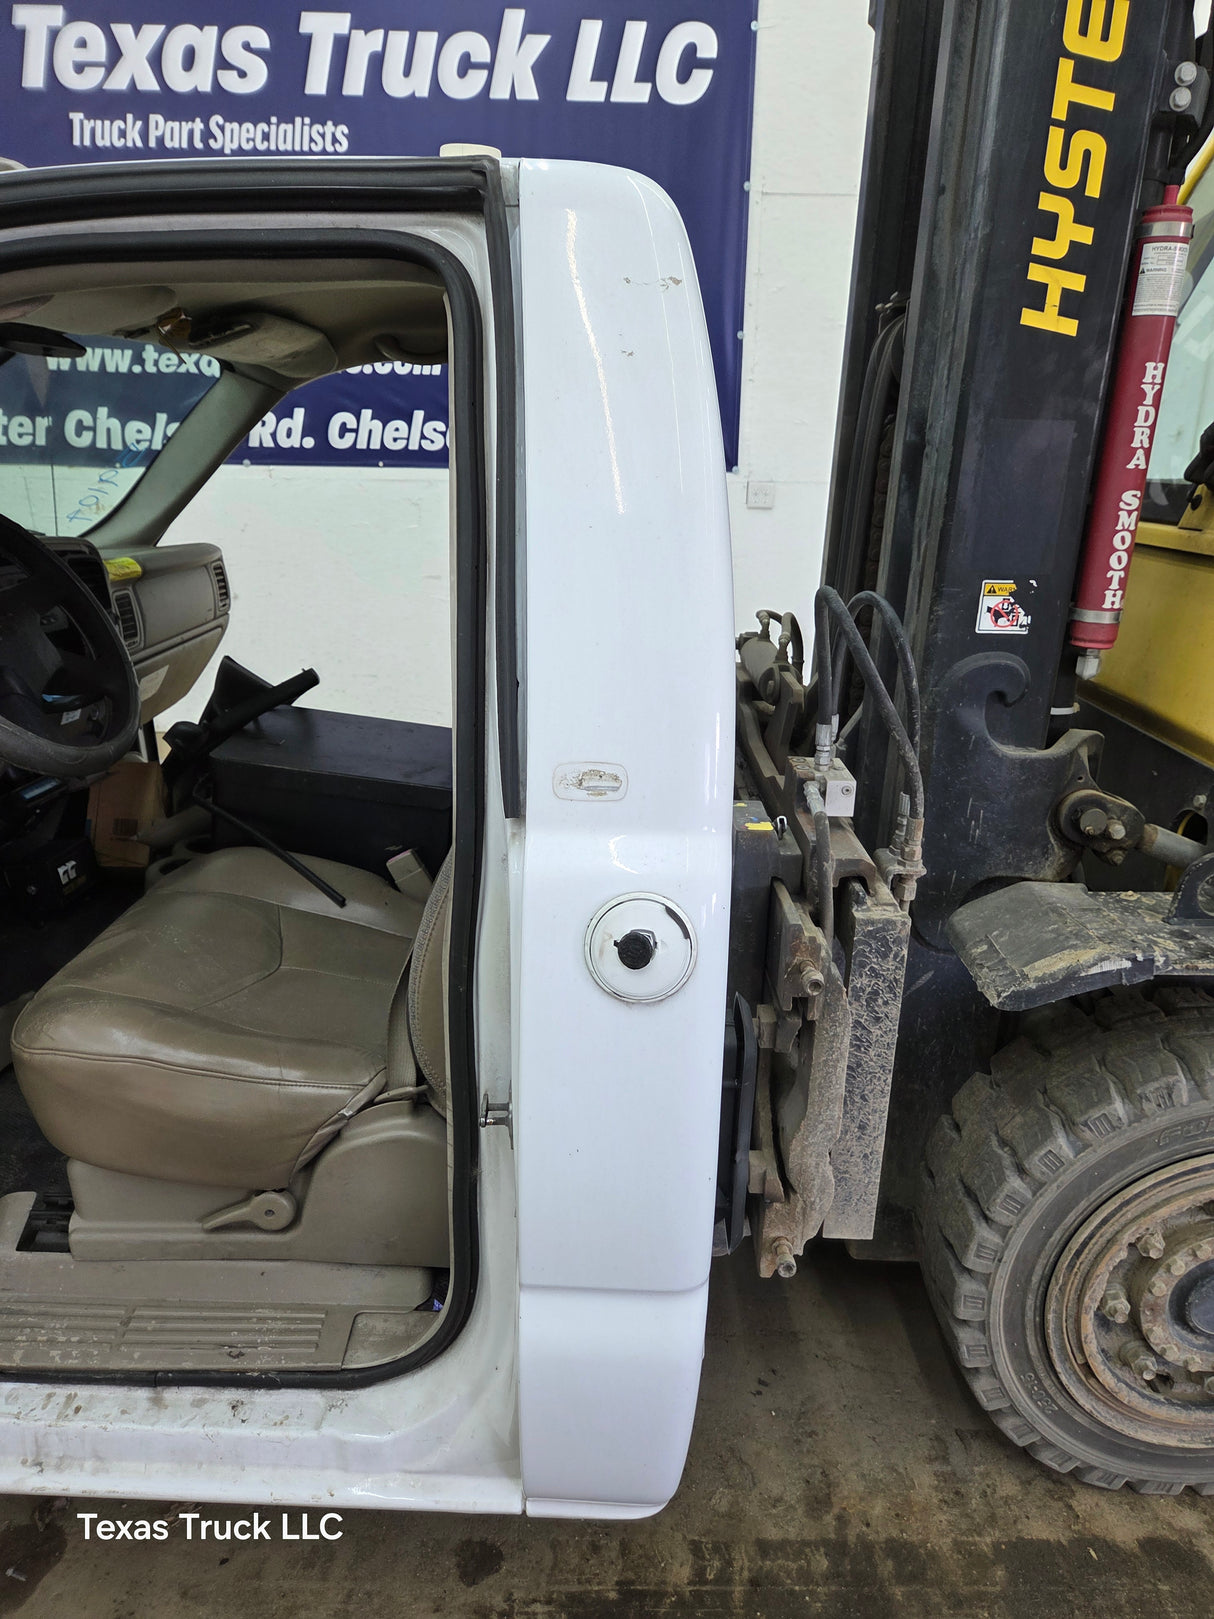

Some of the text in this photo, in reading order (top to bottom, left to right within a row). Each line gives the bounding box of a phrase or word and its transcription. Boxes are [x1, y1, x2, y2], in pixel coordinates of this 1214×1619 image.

[12, 4, 718, 105] Texas Truck LLC
[69, 112, 349, 154] Truck Part Specialists
[247, 407, 316, 449] Rd.
[327, 408, 449, 451] Chels
[1126, 362, 1165, 469] HYDRA
[1102, 490, 1141, 609] SMOOTH
